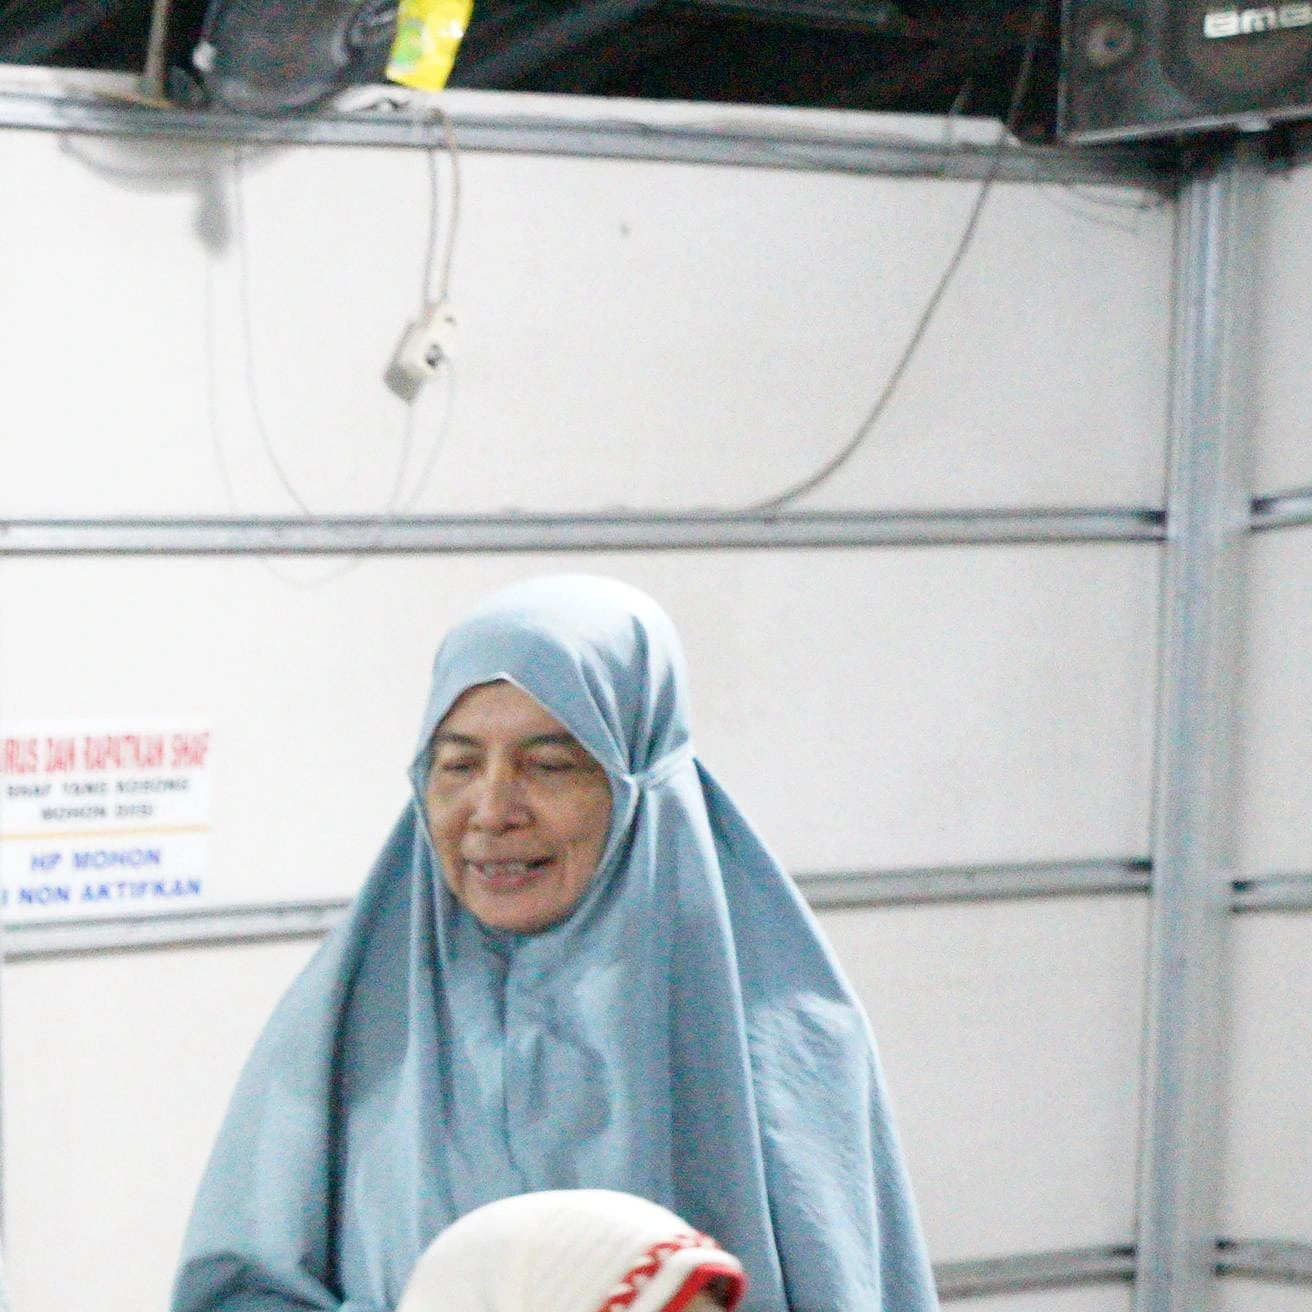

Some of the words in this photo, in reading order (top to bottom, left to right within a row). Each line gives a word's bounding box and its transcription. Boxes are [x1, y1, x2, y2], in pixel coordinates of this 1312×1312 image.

[71, 848, 161, 869] MOHON
[18, 884, 71, 905] NON
[81, 879, 202, 902] AKTIFKAN
